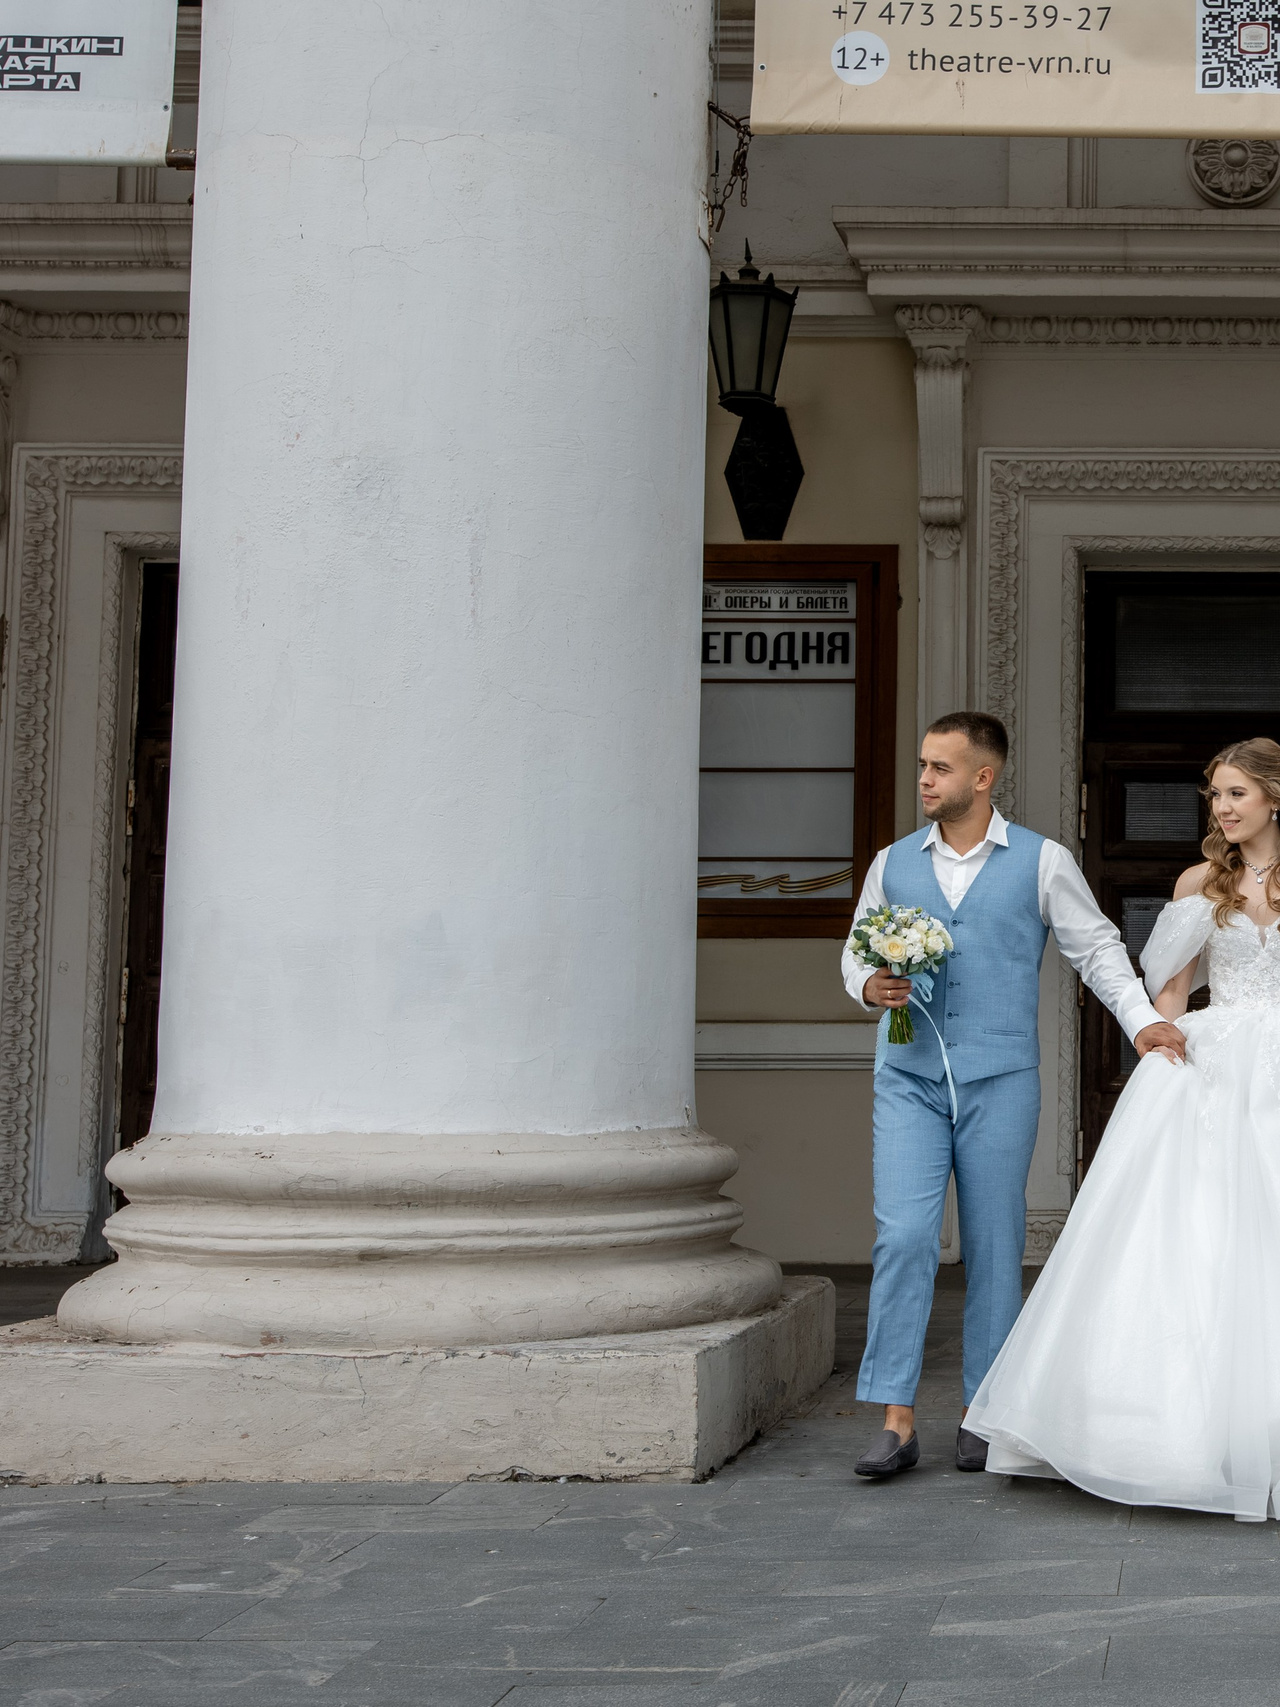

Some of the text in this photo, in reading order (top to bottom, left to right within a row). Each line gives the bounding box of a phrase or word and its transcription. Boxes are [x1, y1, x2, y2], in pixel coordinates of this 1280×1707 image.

[832, 2, 1112, 31] +7 473 255-39-27
[0, 55, 51, 71] АЯ
[836, 47, 885, 70] 12+
[908, 48, 1112, 75] theatre-vrn.ru
[0, 73, 76, 90] РТА
[725, 595, 848, 610] ОПЕРЫ И БАЛЕТА
[702, 631, 850, 671] ЕГОДНЯ
